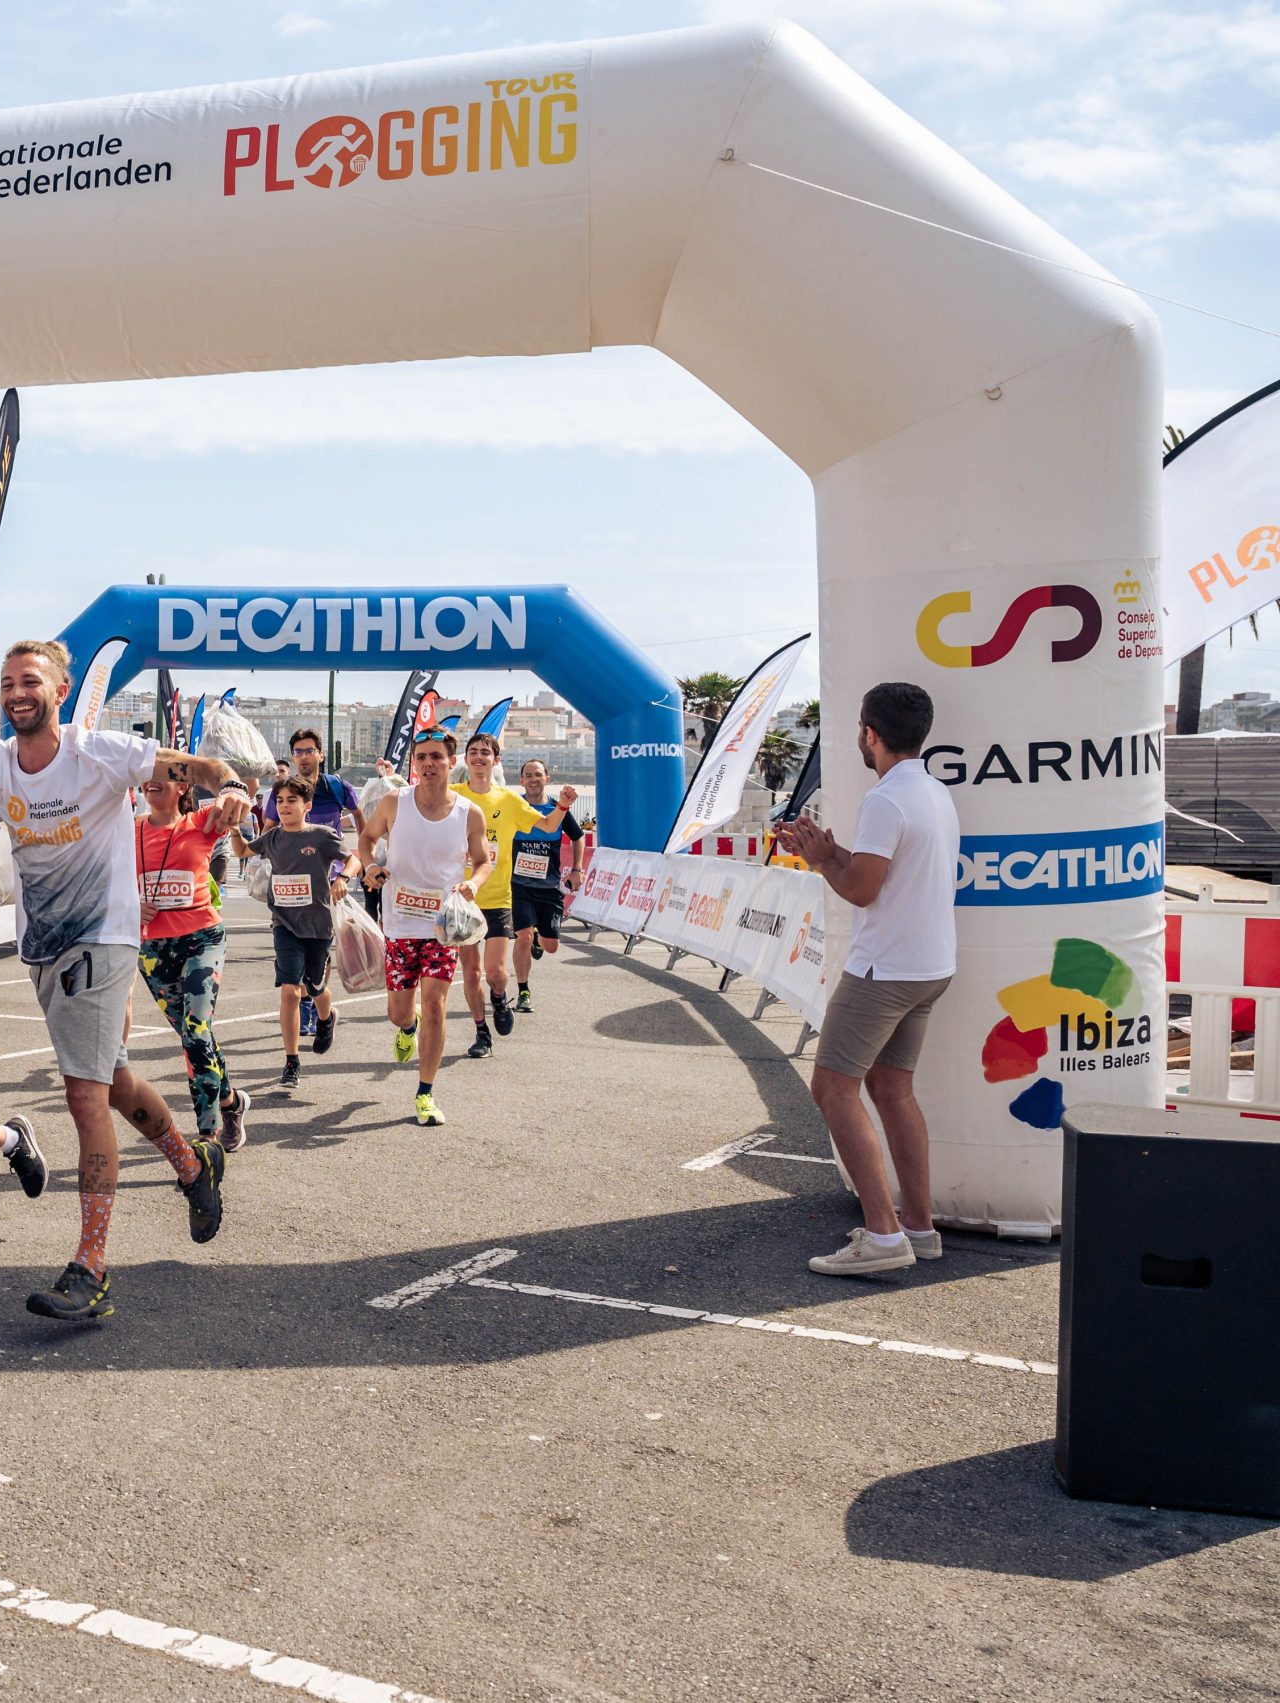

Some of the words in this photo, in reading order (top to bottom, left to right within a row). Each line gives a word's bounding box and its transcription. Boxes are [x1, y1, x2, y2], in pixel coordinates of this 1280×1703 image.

[485, 72, 577, 100] TOUR
[158, 595, 527, 653] DECATHLON
[1117, 609, 1155, 626] Consejo
[1118, 626, 1156, 644] Superior
[1118, 645, 1132, 658] de
[1135, 644, 1163, 660] Deporte
[391, 671, 433, 770] RMIN
[611, 743, 684, 760] DECATHLON
[923, 732, 1162, 786] GARMIN
[695, 777, 714, 818] nationale
[704, 764, 727, 820] nederlanden
[29, 798, 63, 810] ntionale
[30, 804, 80, 819] nderlanden
[956, 837, 1163, 891] DECATHLON
[145, 883, 190, 895] 20400
[274, 885, 307, 895] 20333
[399, 895, 437, 908] 20419
[1060, 1011, 1151, 1052] Ibiza
[1060, 1057, 1096, 1073] Illes
[1103, 1051, 1150, 1071] Balears
